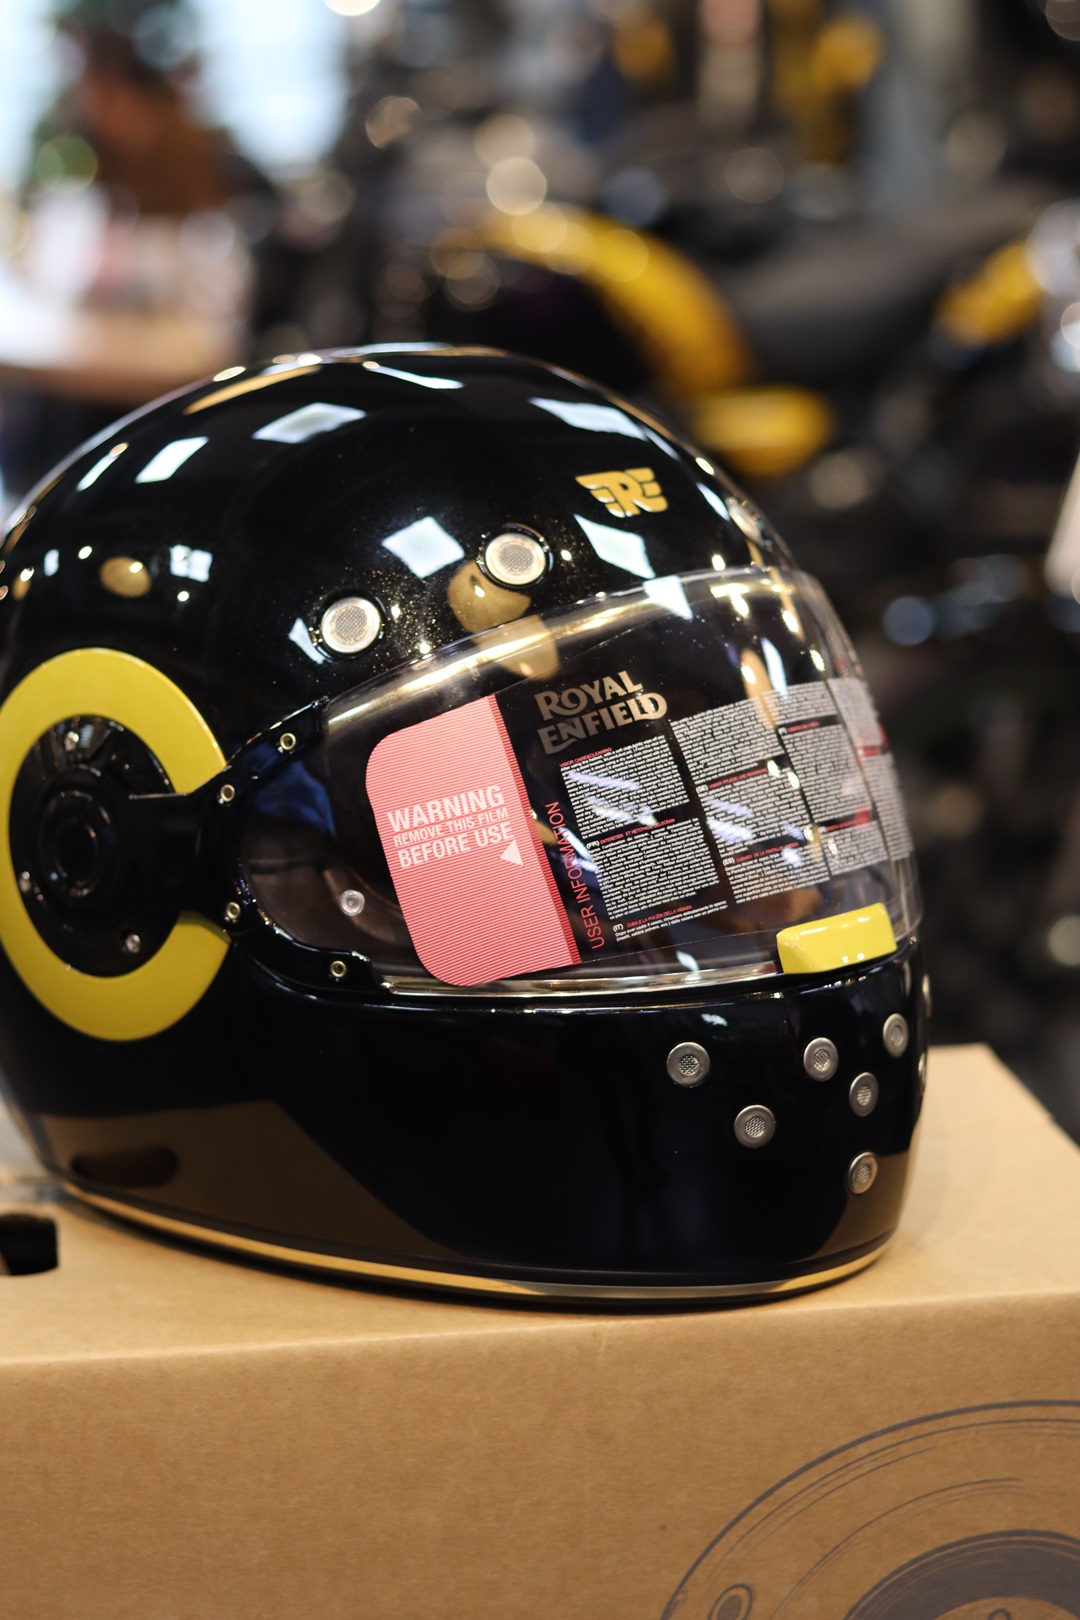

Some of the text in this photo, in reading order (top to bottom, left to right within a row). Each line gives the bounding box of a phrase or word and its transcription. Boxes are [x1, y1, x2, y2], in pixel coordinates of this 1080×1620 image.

[534, 670, 643, 721] ROYAL
[537, 692, 668, 755] ENFIELD
[387, 785, 505, 832] WARNING
[393, 807, 508, 847] REMOVE THIS FILM
[397, 821, 515, 868] BEFORE USE
[545, 801, 605, 949] USER INFORMATION
